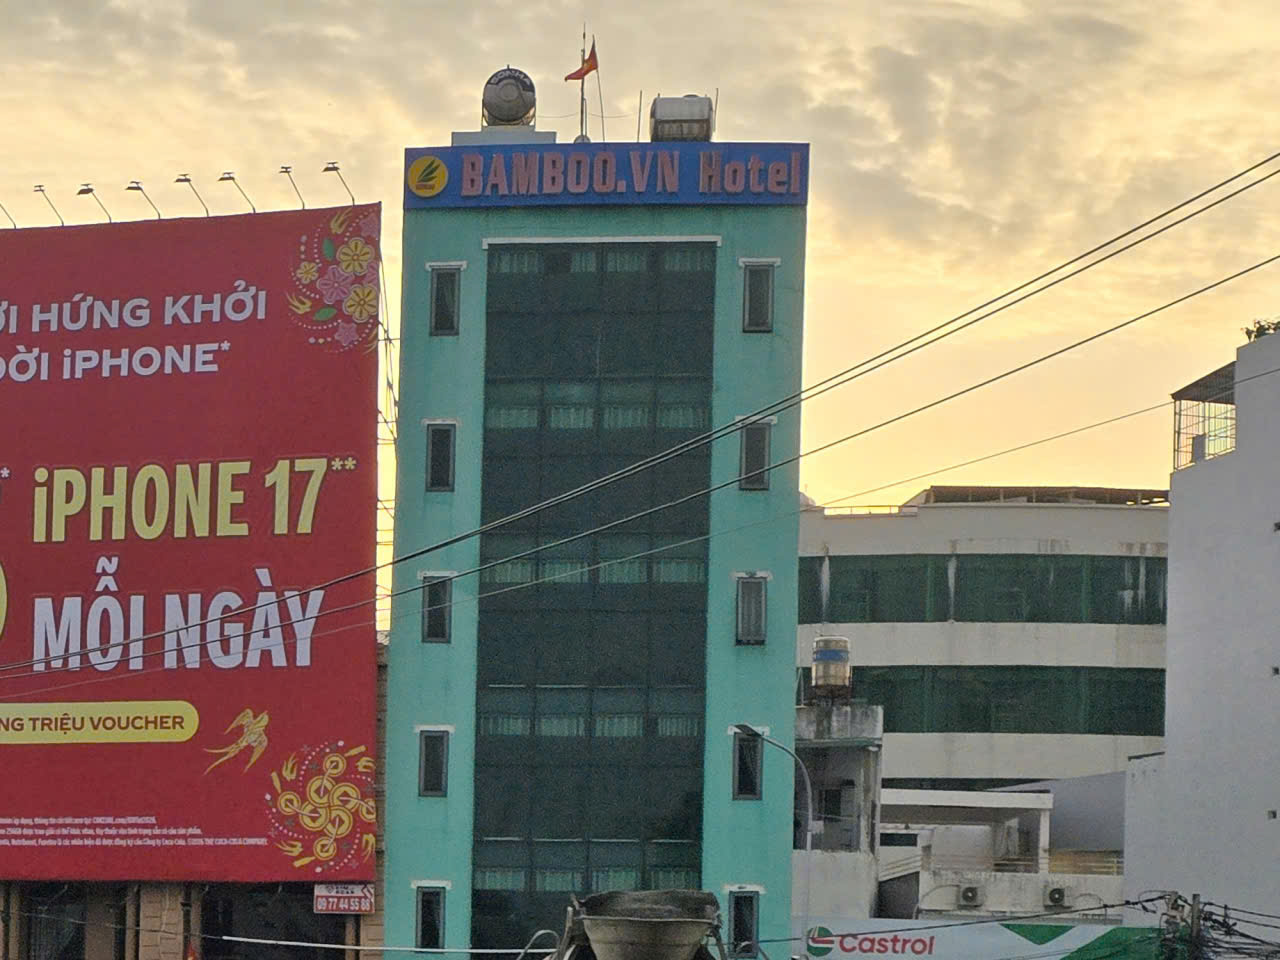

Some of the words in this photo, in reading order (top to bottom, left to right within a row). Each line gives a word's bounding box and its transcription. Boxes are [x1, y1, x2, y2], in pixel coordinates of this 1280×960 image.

[461, 151, 680, 197] BAMBOO.VN
[698, 150, 802, 194] Hotel
[32, 286, 150, 333] HỨNG
[165, 279, 267, 326] KHỞI
[33, 461, 251, 543] iPHONE
[33, 556, 145, 672] MỖI
[165, 568, 326, 670] NGÀY
[28, 713, 85, 735] TRIỆU
[89, 715, 185, 731] VOUCHER
[840, 935, 935, 955] Castrol
